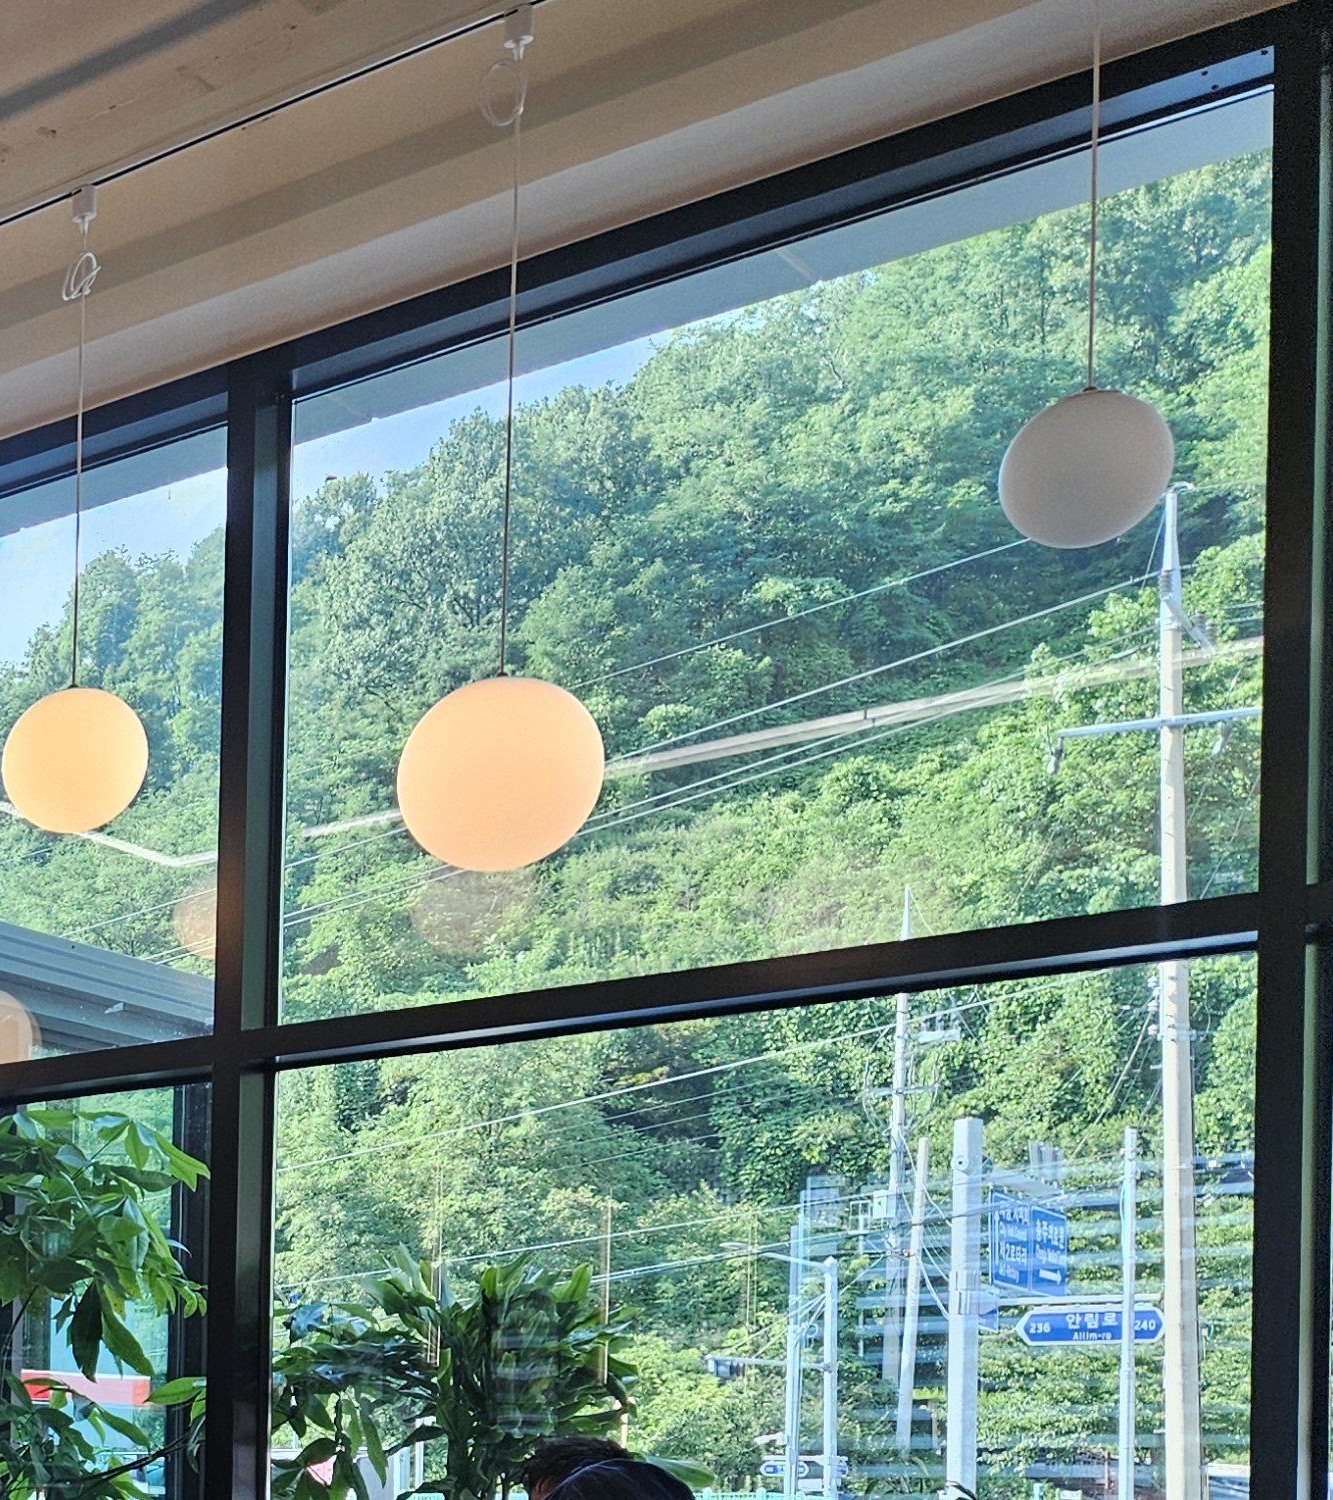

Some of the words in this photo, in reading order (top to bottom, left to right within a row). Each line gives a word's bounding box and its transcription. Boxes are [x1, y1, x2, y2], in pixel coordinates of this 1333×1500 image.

[1065, 1312, 1118, 1329] 안림로
[1134, 1319, 1156, 1331] 240
[1029, 1322, 1051, 1334] 236
[1072, 1331, 1112, 1341] Allim-ro
